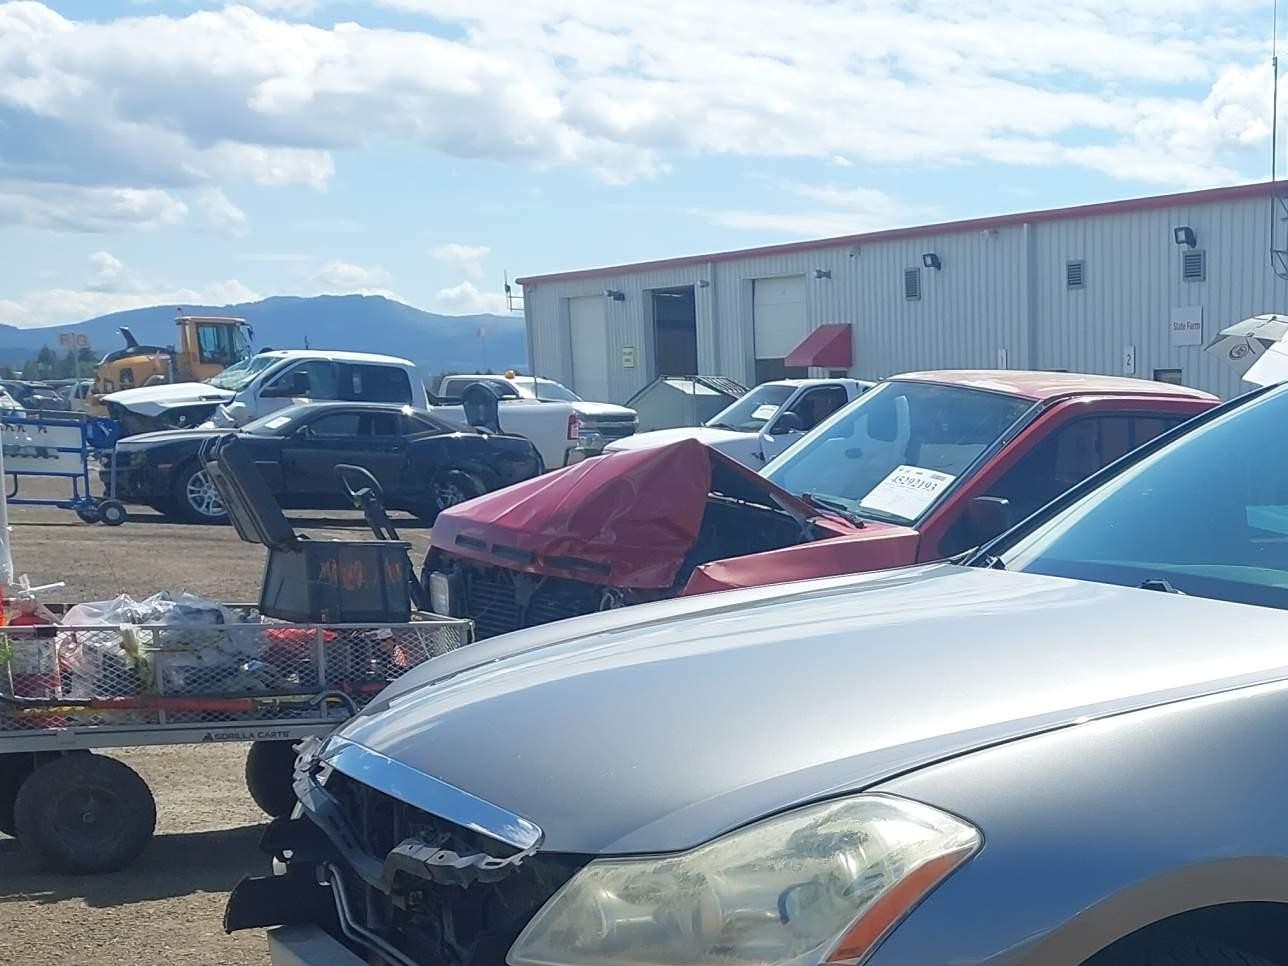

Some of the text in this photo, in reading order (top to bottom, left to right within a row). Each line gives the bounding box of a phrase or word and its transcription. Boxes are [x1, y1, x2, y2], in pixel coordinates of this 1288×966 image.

[1173, 321, 1200, 330] State Farm
[1126, 353, 1131, 366] 2
